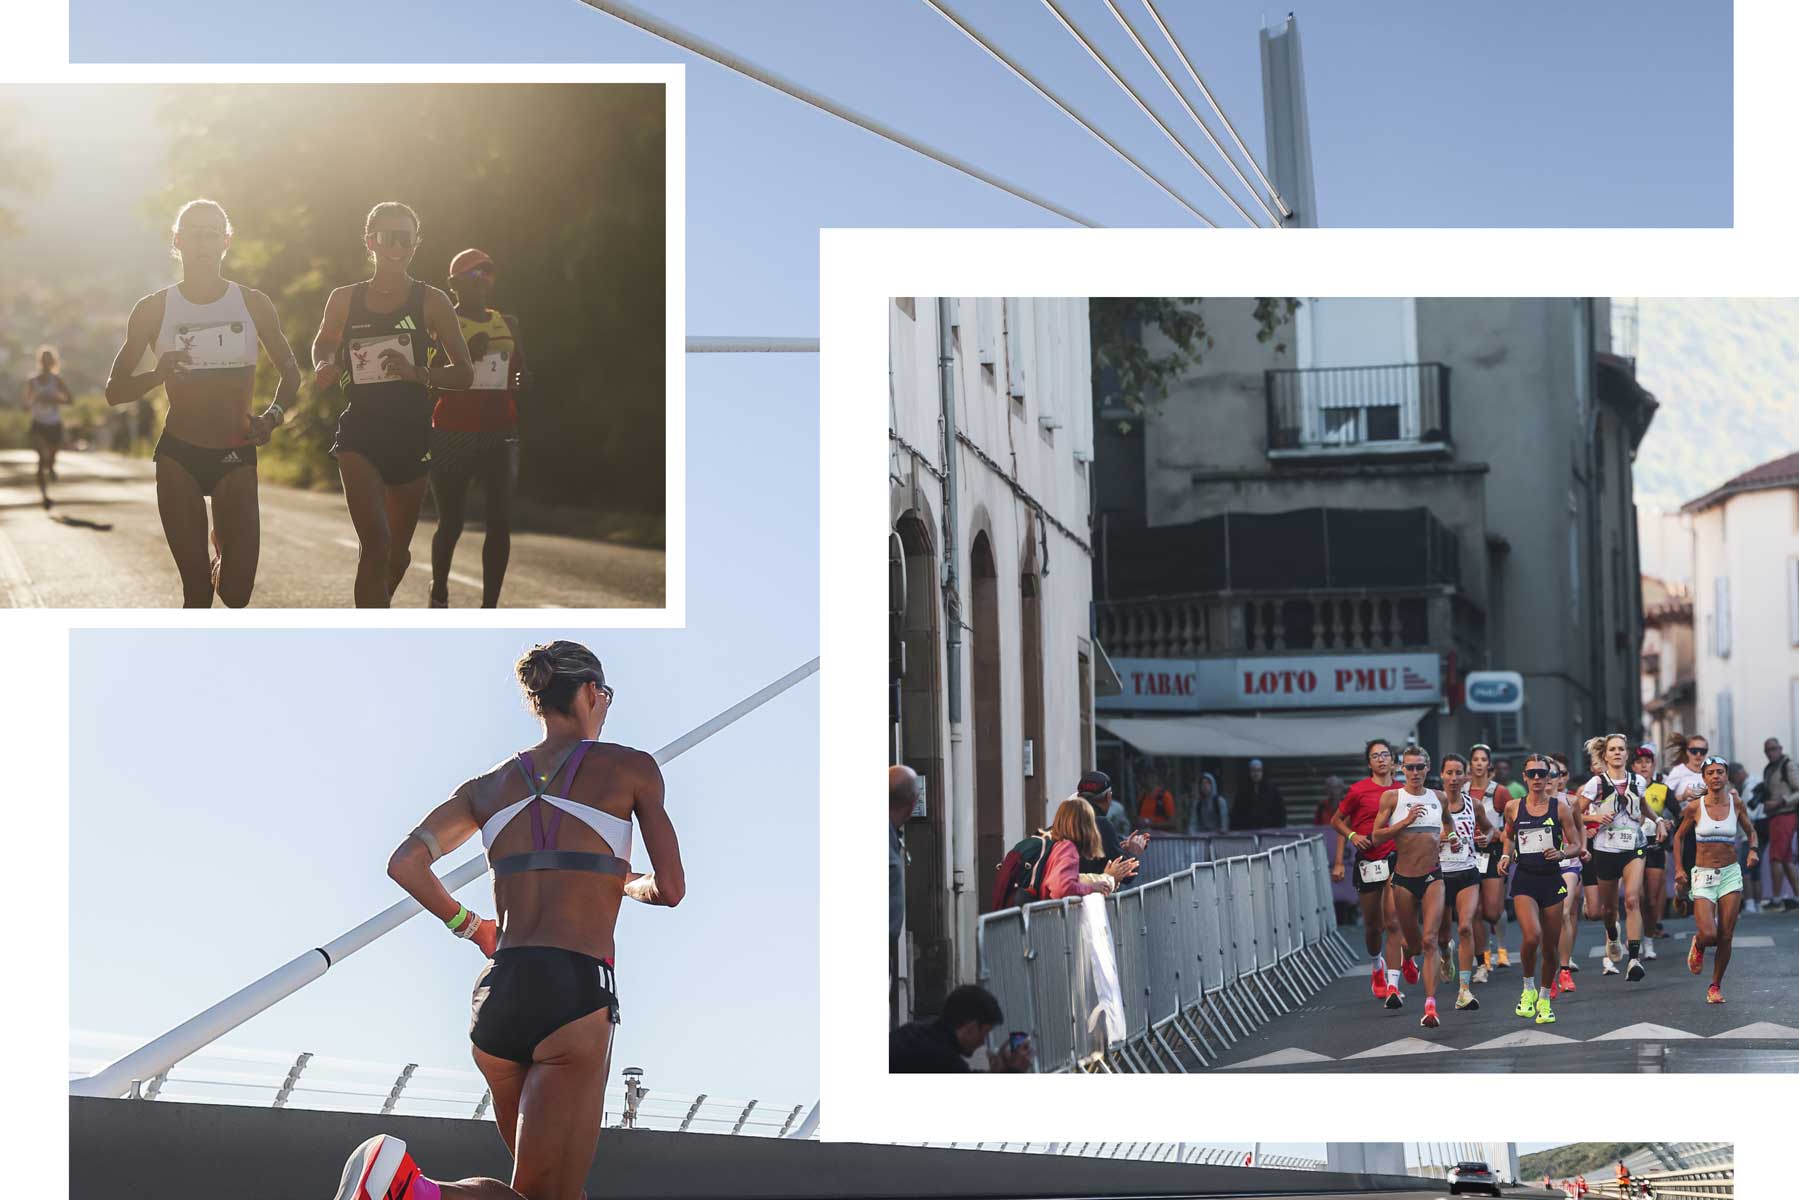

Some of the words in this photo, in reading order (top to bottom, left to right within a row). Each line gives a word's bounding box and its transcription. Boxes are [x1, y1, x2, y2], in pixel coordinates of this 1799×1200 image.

[217, 333, 223, 347] 1
[491, 360, 497, 373] 2
[1131, 671, 1197, 696] TABAC
[1244, 670, 1317, 695] LOTO
[1334, 667, 1398, 692] PMU
